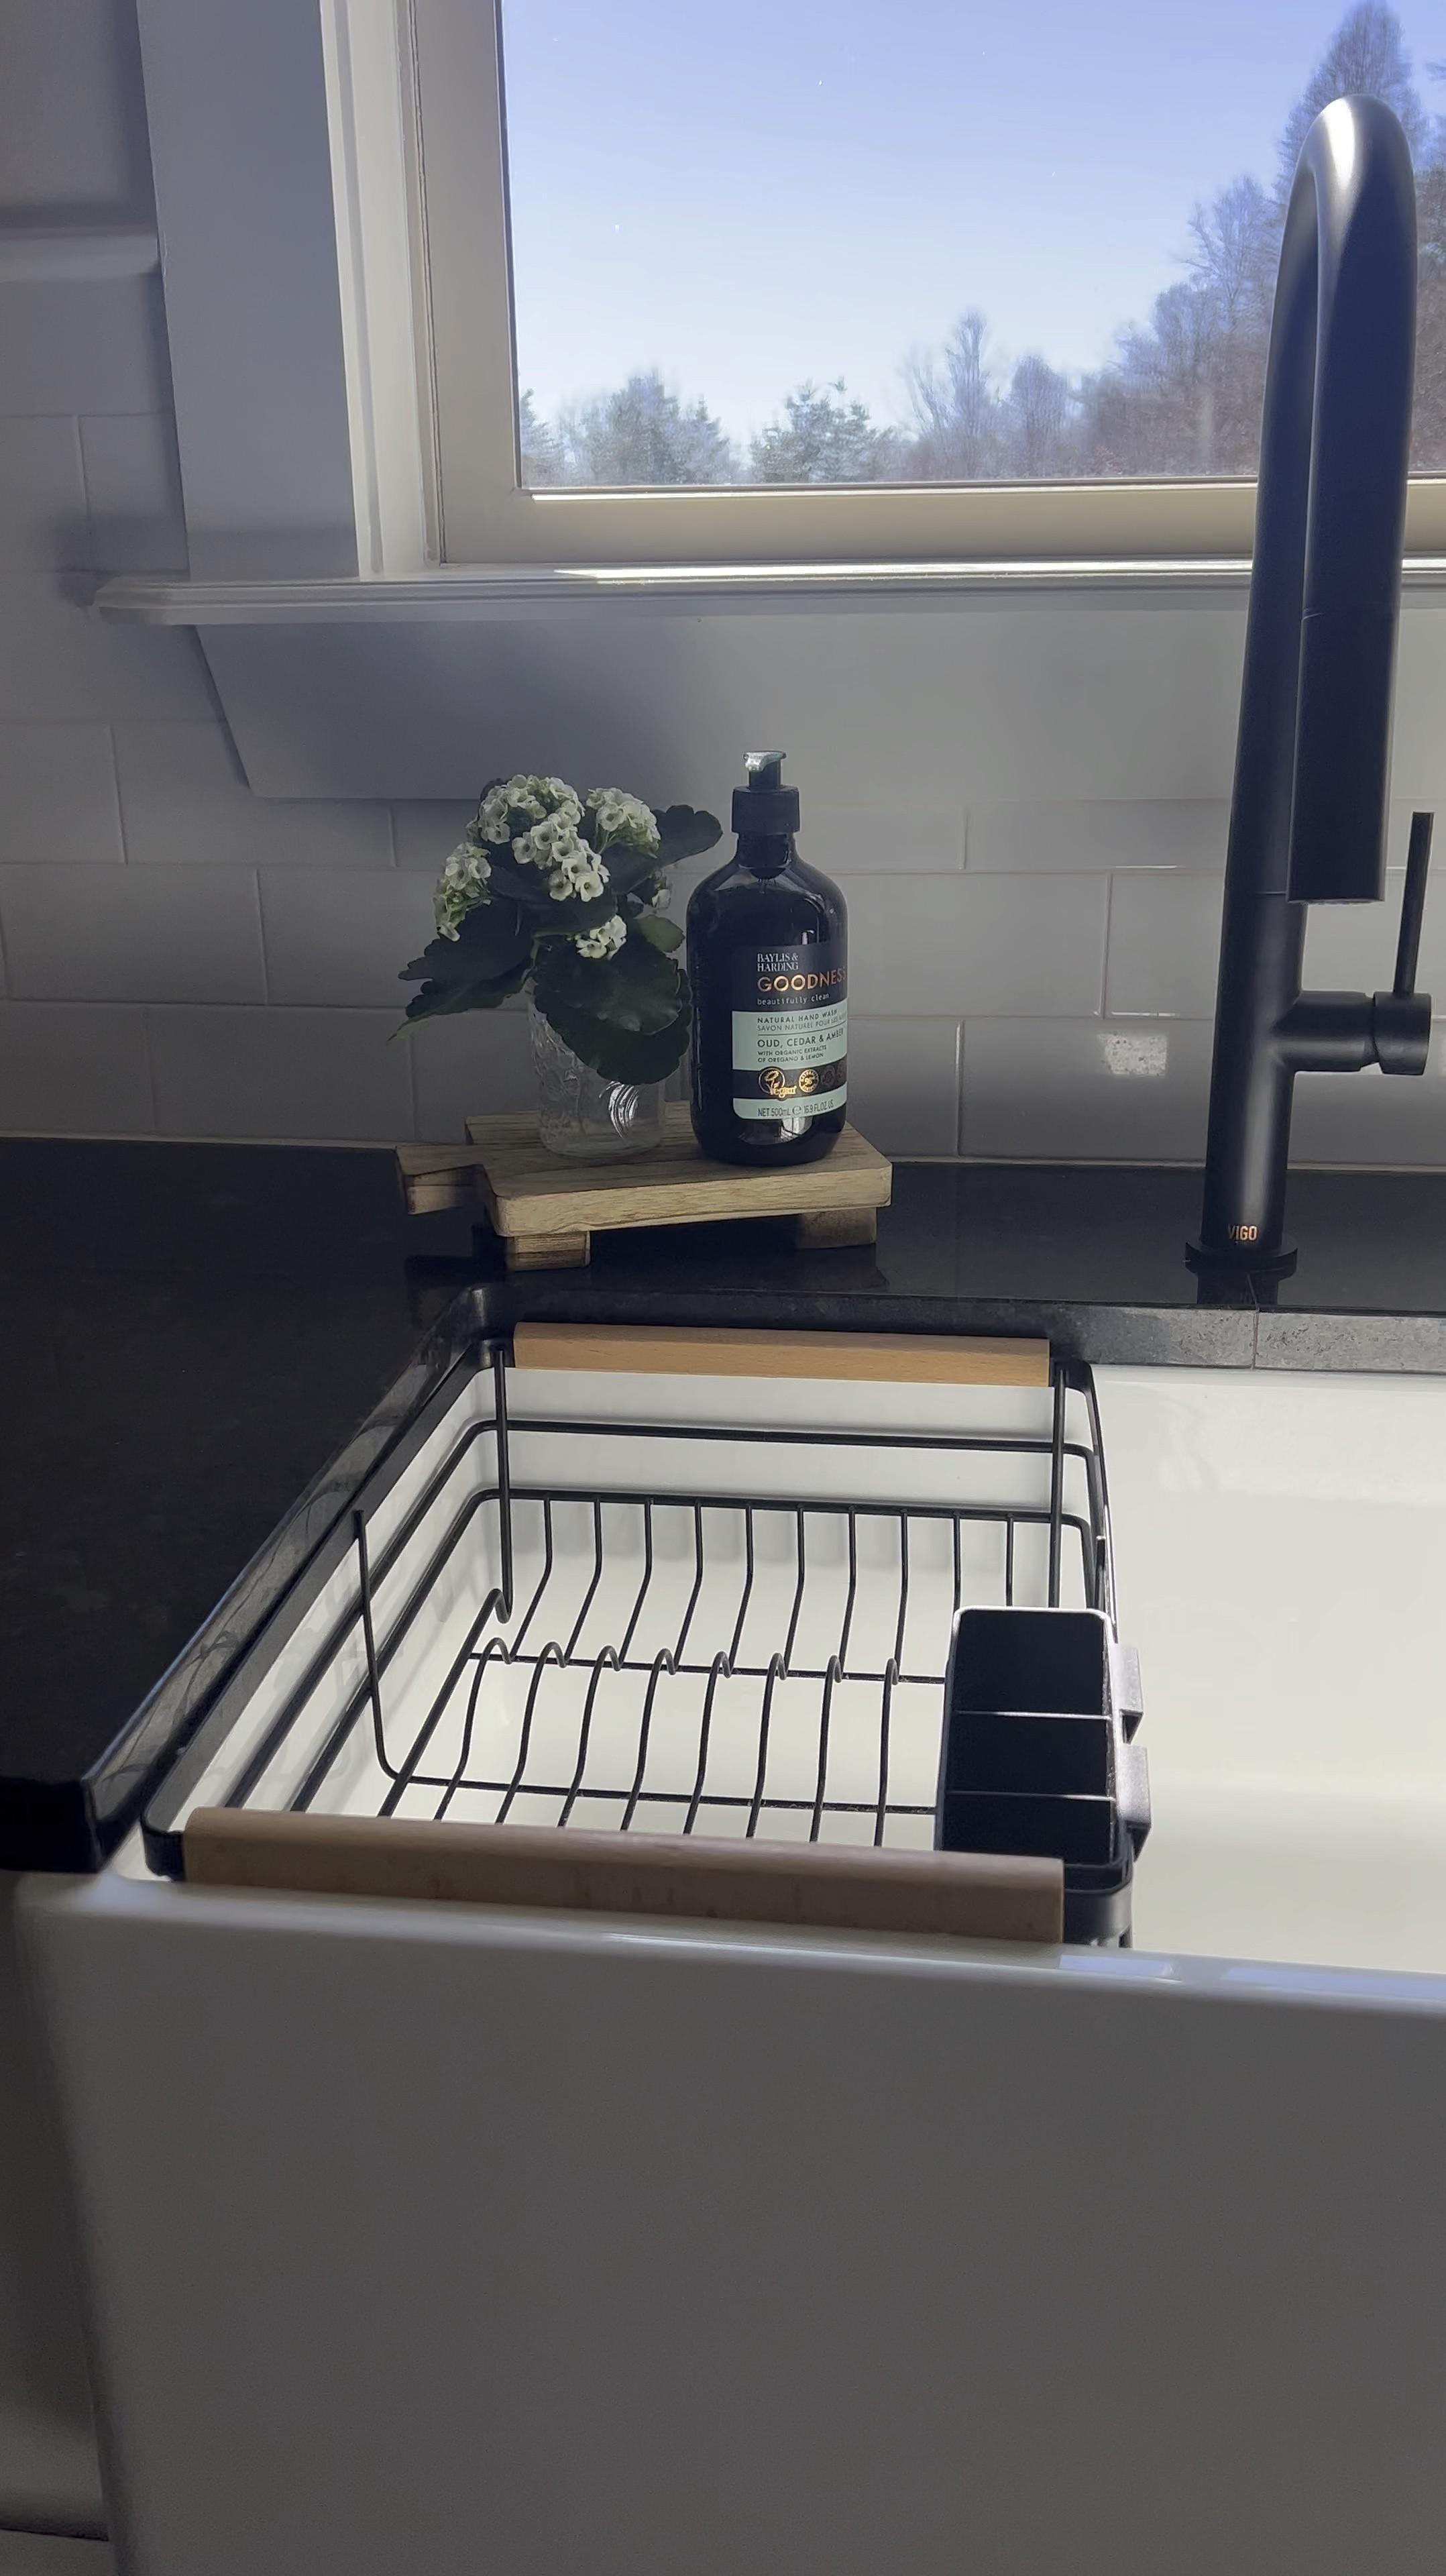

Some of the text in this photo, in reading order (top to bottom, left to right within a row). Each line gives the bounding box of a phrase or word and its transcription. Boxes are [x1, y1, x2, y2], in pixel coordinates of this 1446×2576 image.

[757, 953, 799, 962] BAYLIS &
[757, 962, 799, 972] HARDING
[757, 994, 830, 1006] beautifully clean
[785, 1022, 813, 1030] NATUREL
[757, 1039, 783, 1049] OUD,
[786, 1036, 816, 1047] CEDAR
[818, 1034, 824, 1042] &
[758, 1108, 769, 1117] NET
[1228, 1225, 1258, 1241] VIGO
